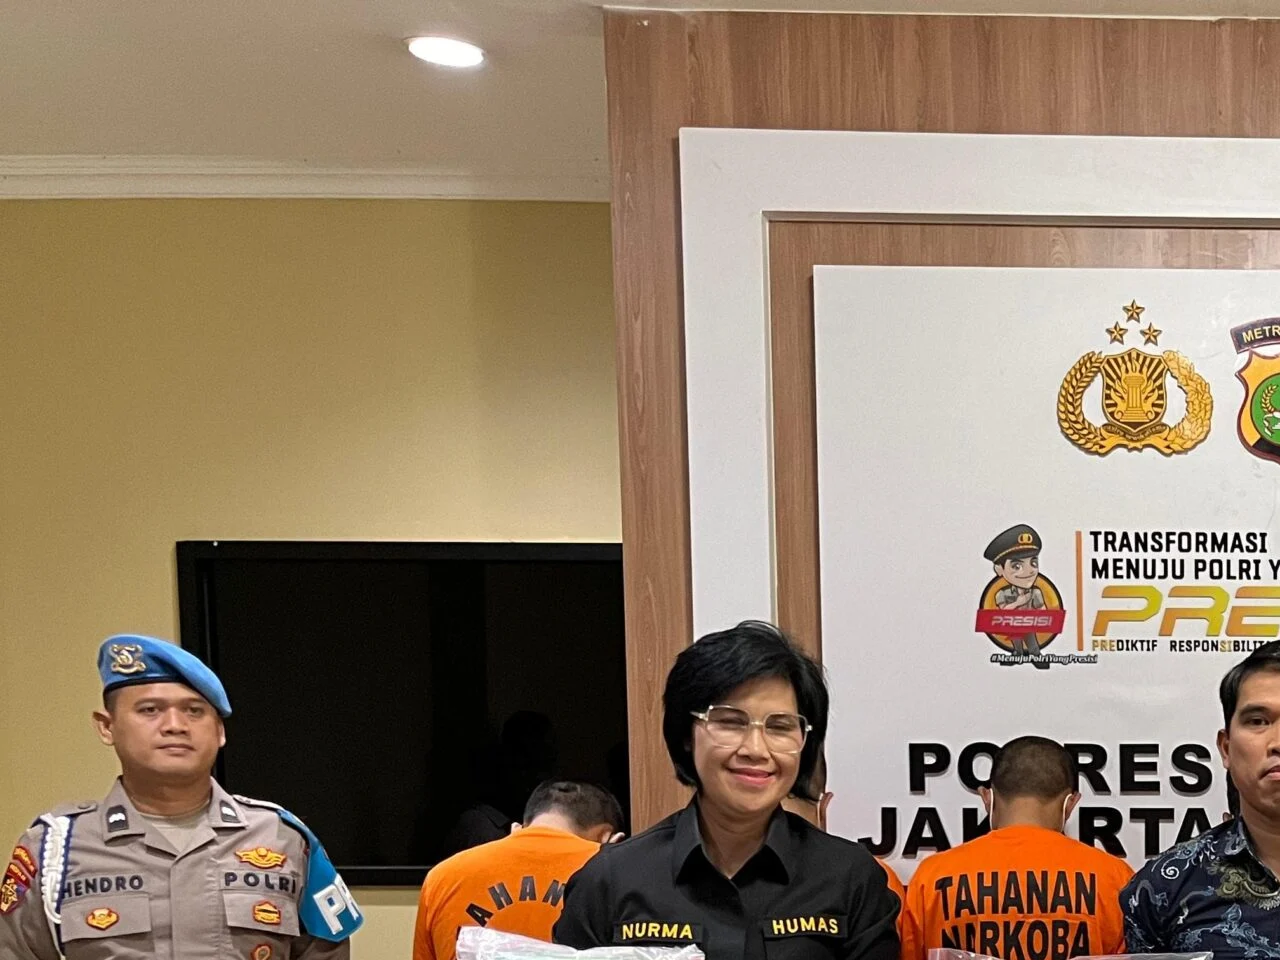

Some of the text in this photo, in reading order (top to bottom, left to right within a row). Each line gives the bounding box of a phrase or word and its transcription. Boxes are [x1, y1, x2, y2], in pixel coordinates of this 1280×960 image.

[1090, 531, 1268, 553] TRANSFORMASI
[1091, 558, 1185, 580] MENUJU
[1194, 559, 1262, 580] POLRI
[991, 615, 1053, 627] PRESISI
[1092, 639, 1158, 652] PREDIKTIF
[1170, 640, 1273, 652] RESPONSIBILIT
[908, 742, 1213, 796] PORES
[857, 806, 1213, 859] JAKRTA
[63, 875, 144, 898] HENDRO
[224, 871, 297, 895] POLRI
[935, 871, 1096, 921] TAHANAN
[622, 923, 693, 940] NURMA
[772, 916, 839, 935] HUMAS
